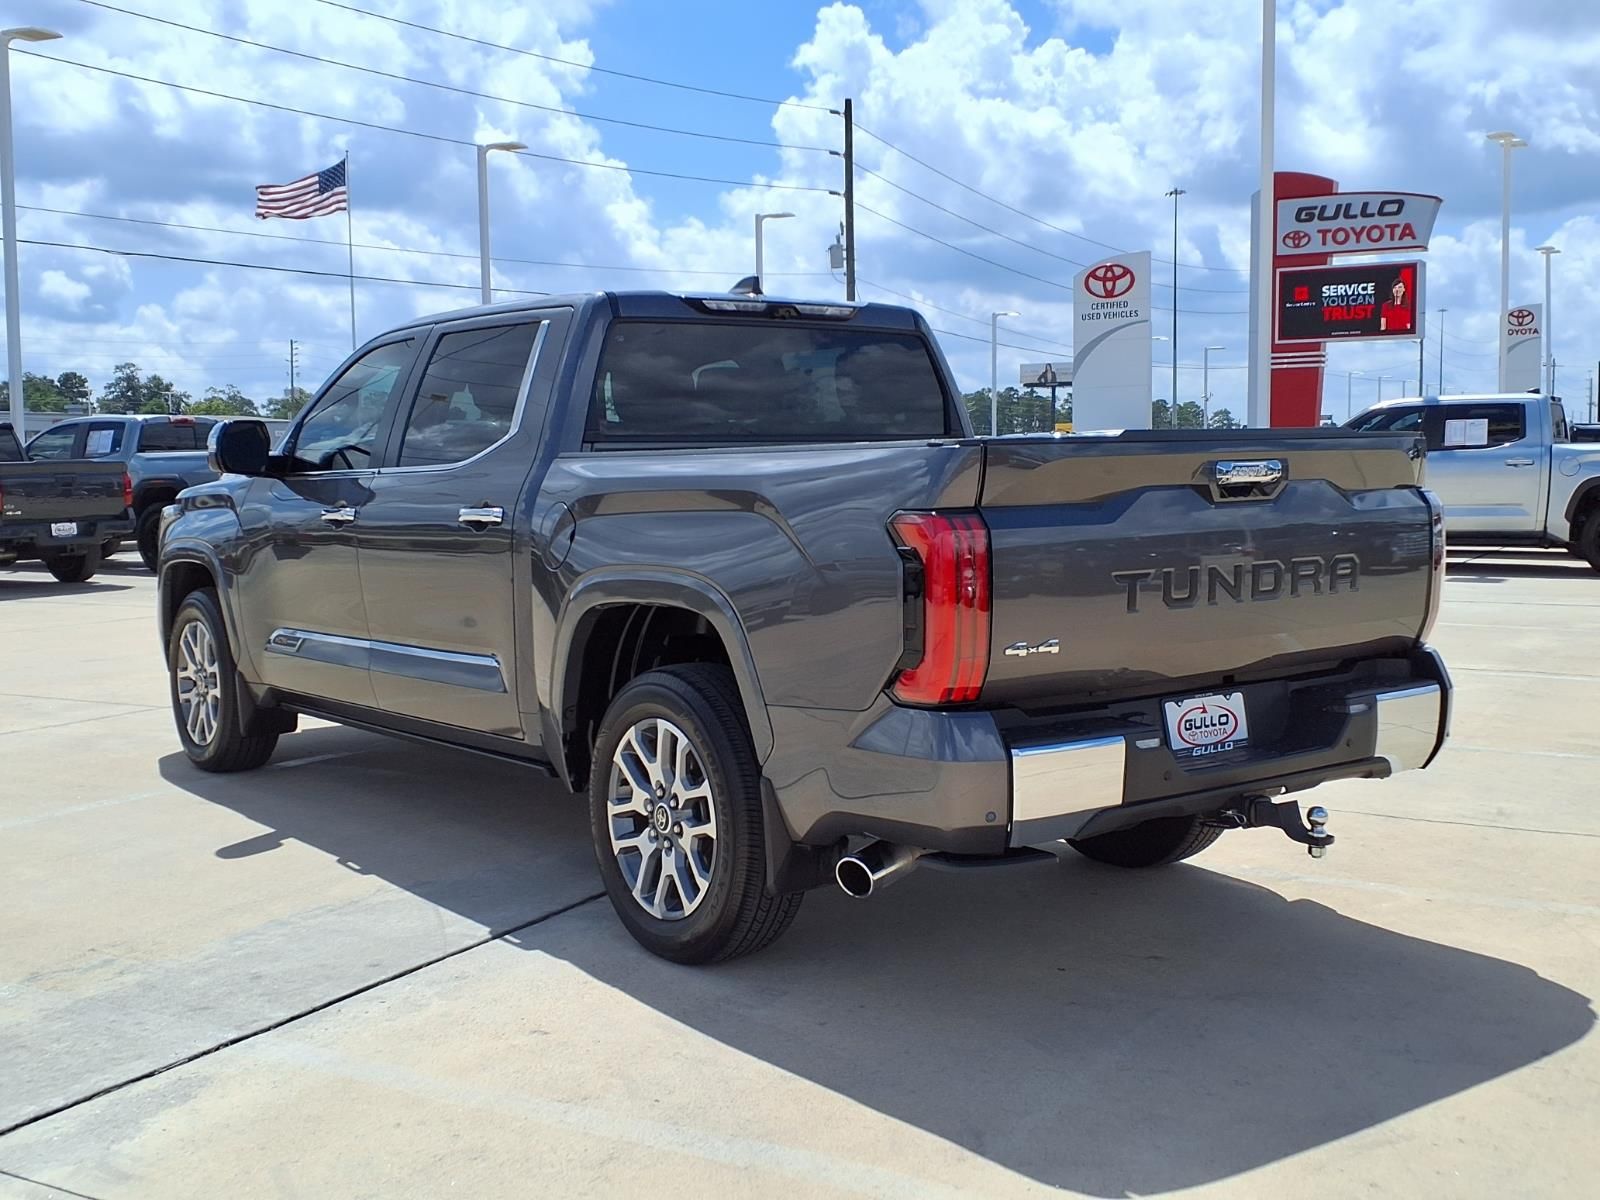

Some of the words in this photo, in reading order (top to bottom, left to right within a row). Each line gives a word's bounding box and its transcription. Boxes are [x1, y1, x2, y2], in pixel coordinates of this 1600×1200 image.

[1294, 198, 1405, 223] GULLO
[1316, 222, 1417, 246] TOYOTA
[1321, 282, 1376, 297] SERVICE
[1091, 300, 1129, 311] CERTIFIED
[1321, 296, 1347, 307] YOU
[1348, 295, 1375, 306] CAN
[1081, 312, 1101, 321] USED
[1103, 309, 1139, 320] VEHICLES
[1322, 304, 1376, 321] TRUST
[1507, 328, 1539, 336] OYOTA
[1111, 552, 1361, 614] TUNDRA
[1184, 713, 1230, 731] GULLO
[1199, 727, 1228, 738] TOYOTA
[1192, 741, 1234, 757] GULLO
